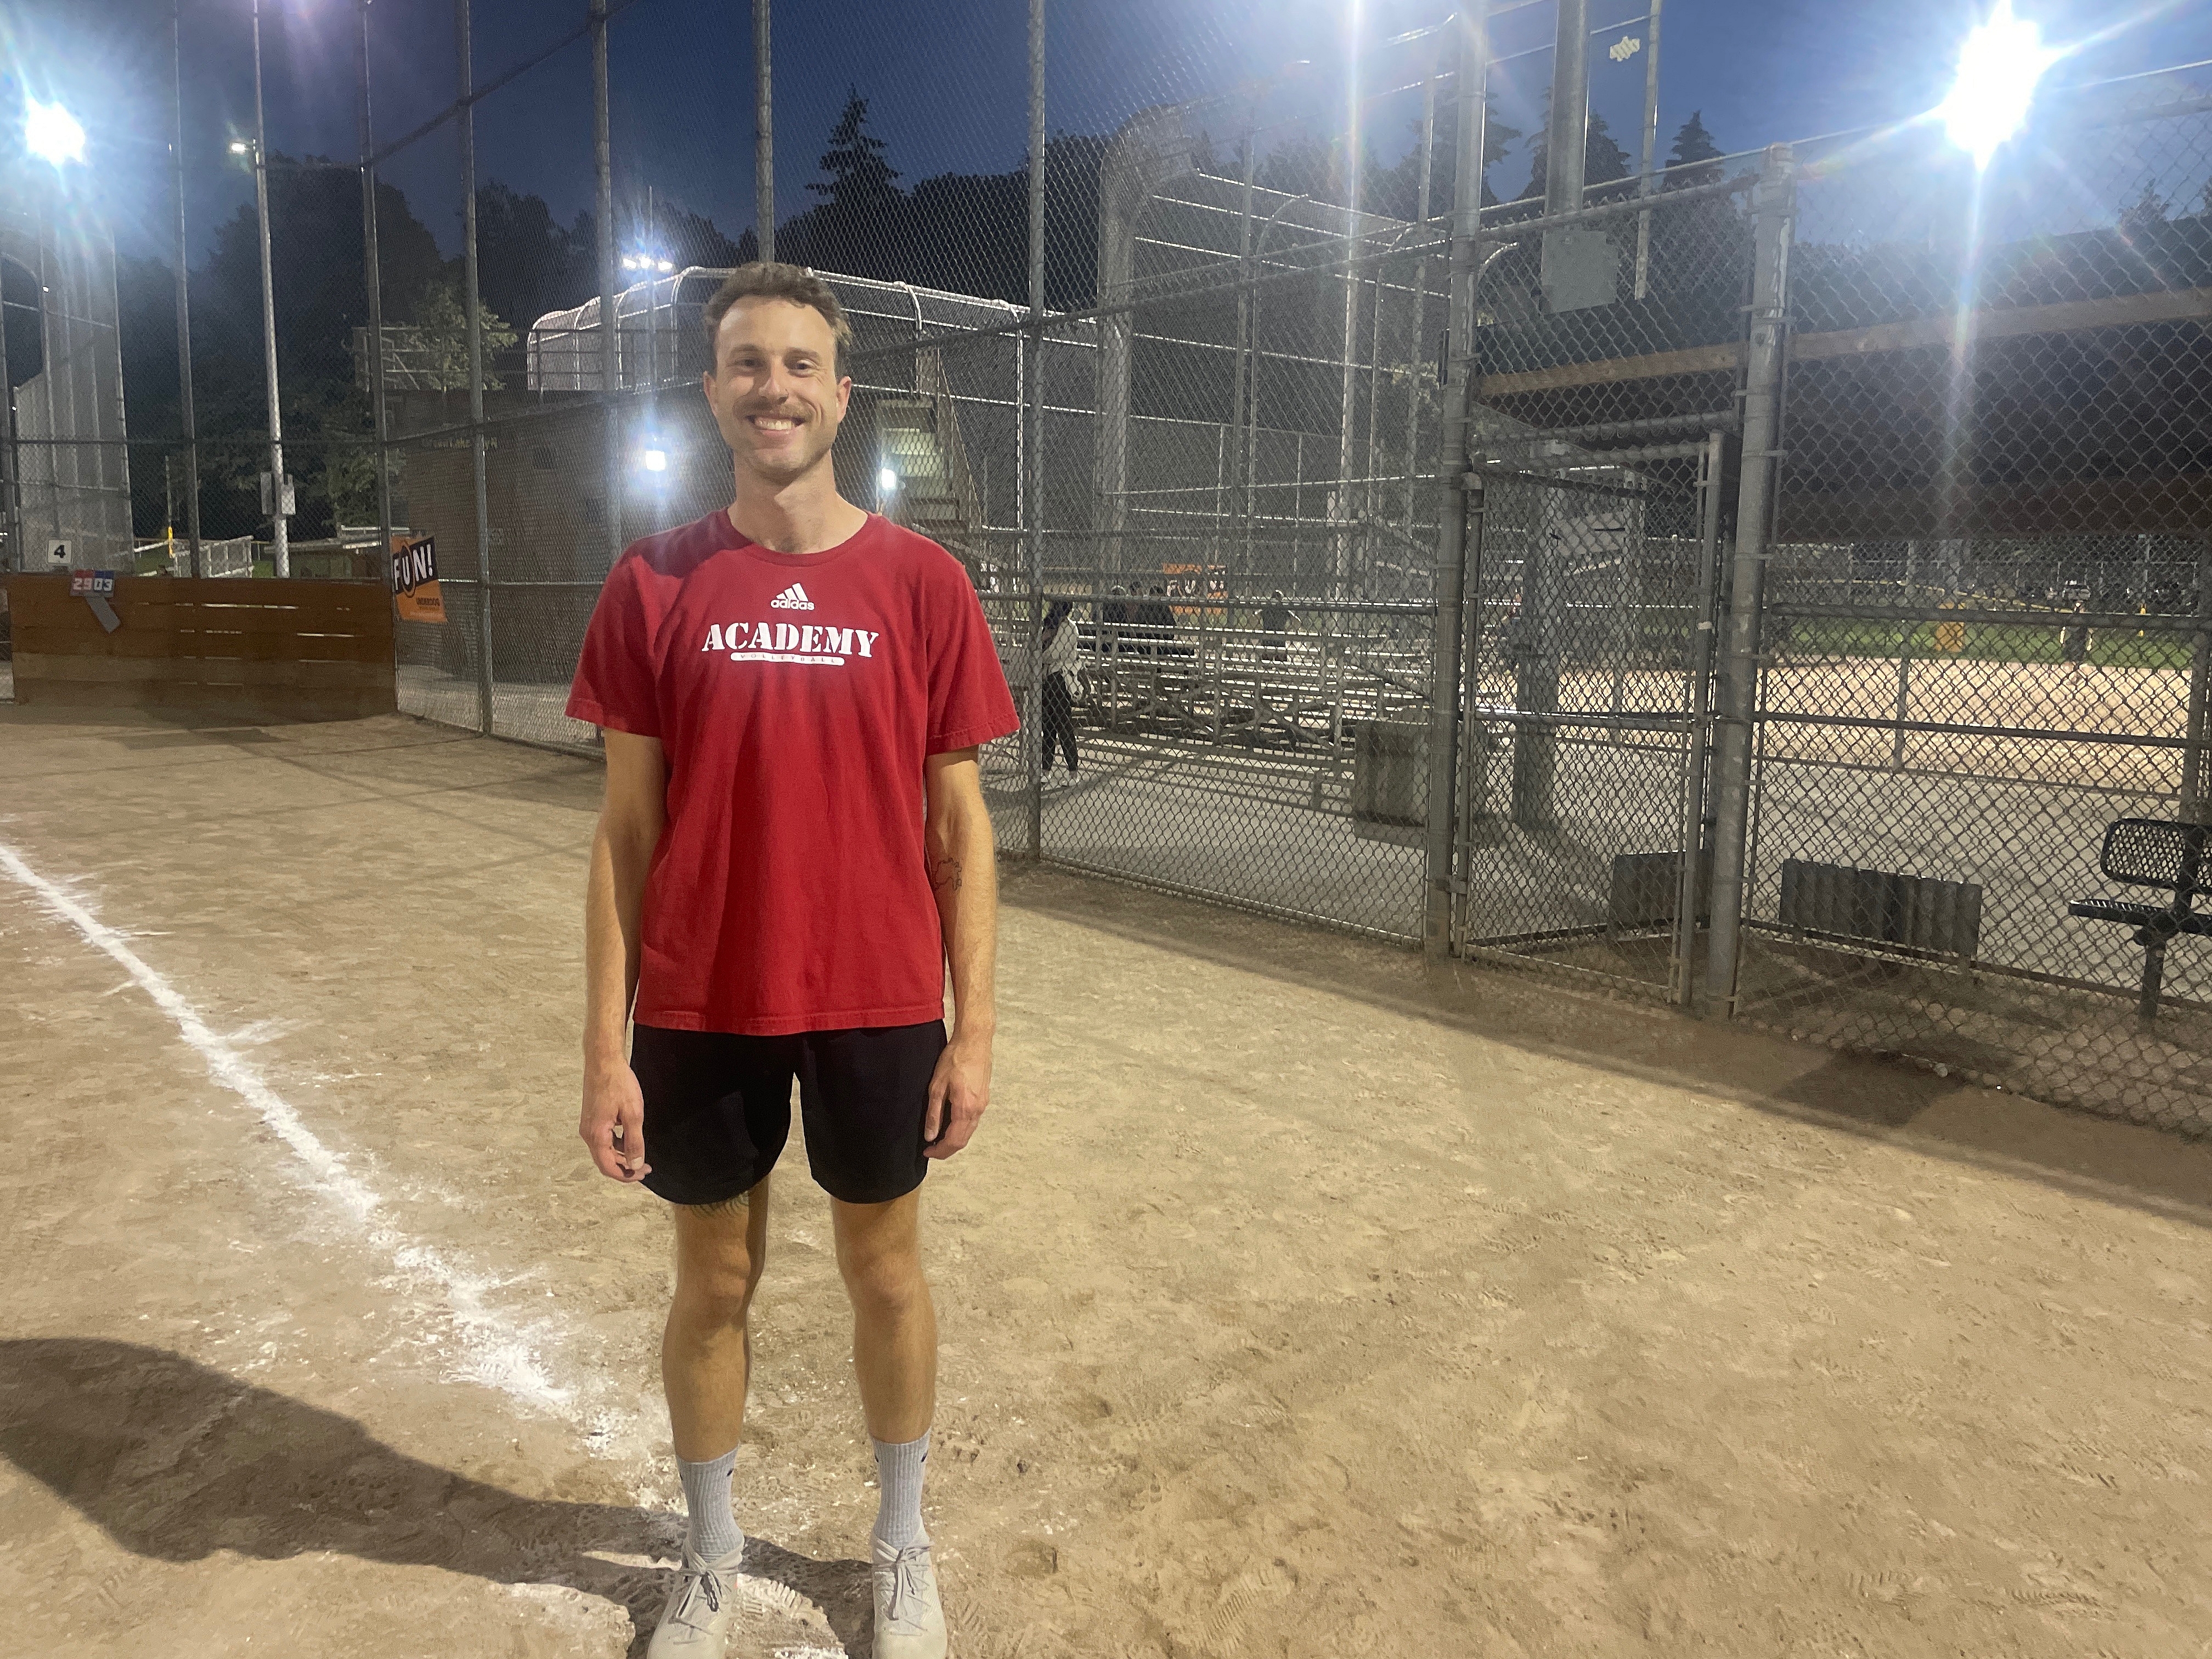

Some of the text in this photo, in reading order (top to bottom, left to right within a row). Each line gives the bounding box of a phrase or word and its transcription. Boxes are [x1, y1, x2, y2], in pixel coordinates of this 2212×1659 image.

[54, 544, 66, 558] 4
[393, 544, 433, 591] FUN!
[770, 598, 815, 611] adidas
[701, 622, 879, 658] ACADEMY
